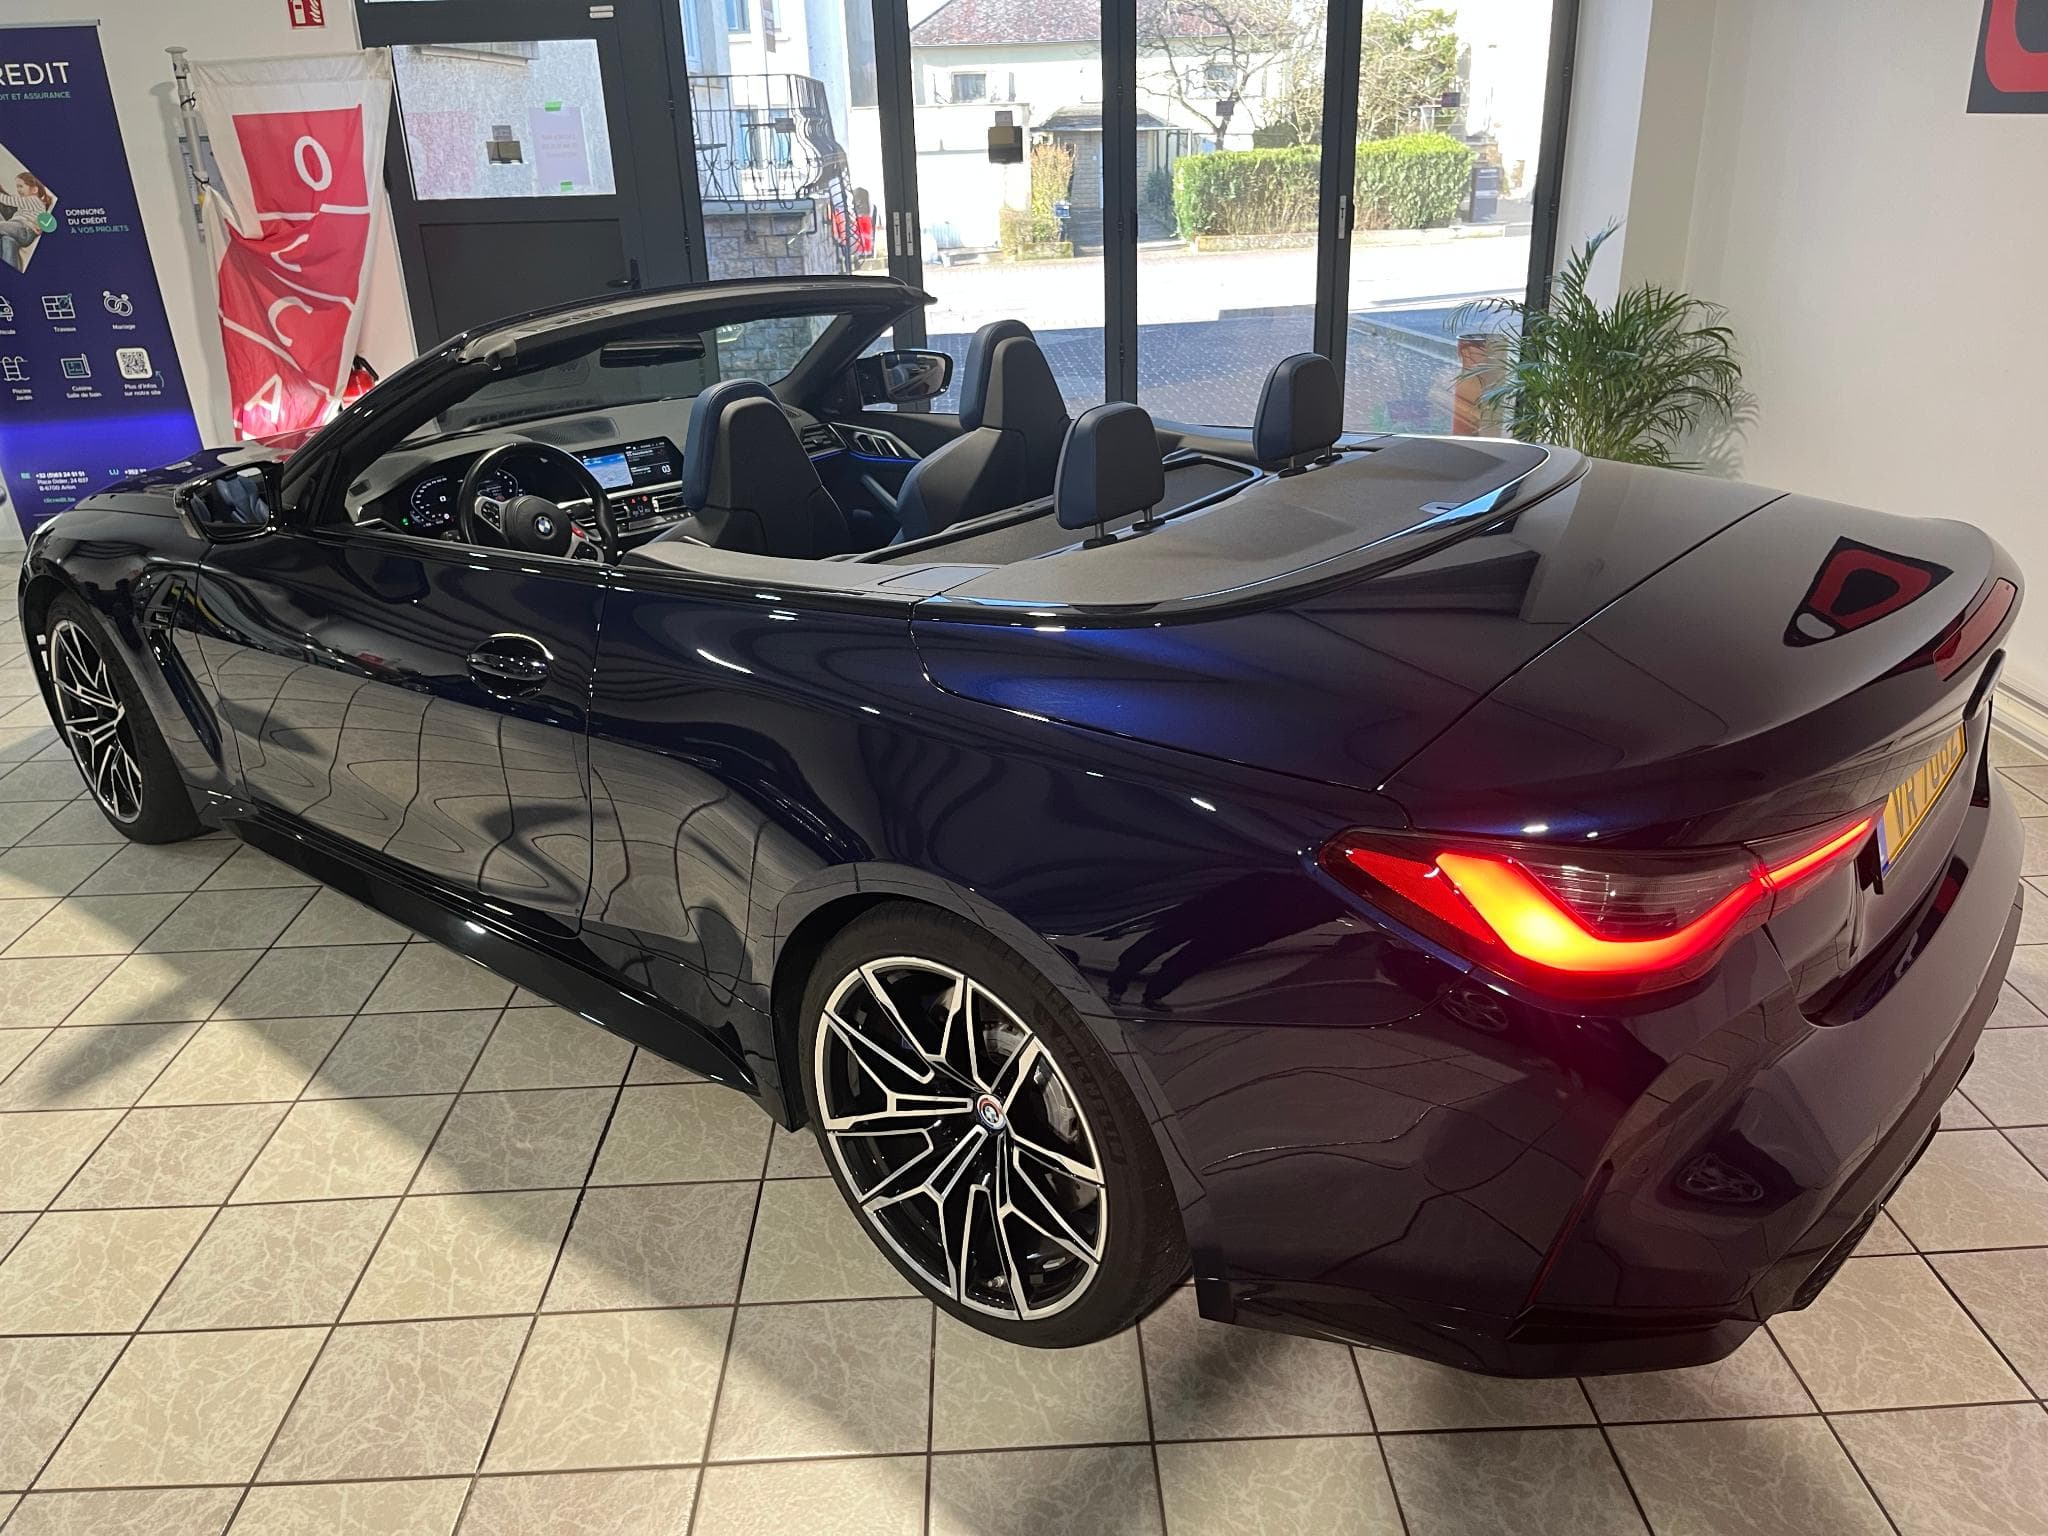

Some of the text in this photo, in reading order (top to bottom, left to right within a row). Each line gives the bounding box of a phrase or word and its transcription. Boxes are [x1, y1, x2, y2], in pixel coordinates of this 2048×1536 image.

[11, 93, 21, 101] ET
[24, 91, 72, 100] ASSURANCE
[65, 208, 105, 216] DONNONS
[96, 225, 129, 233] PROJETS
